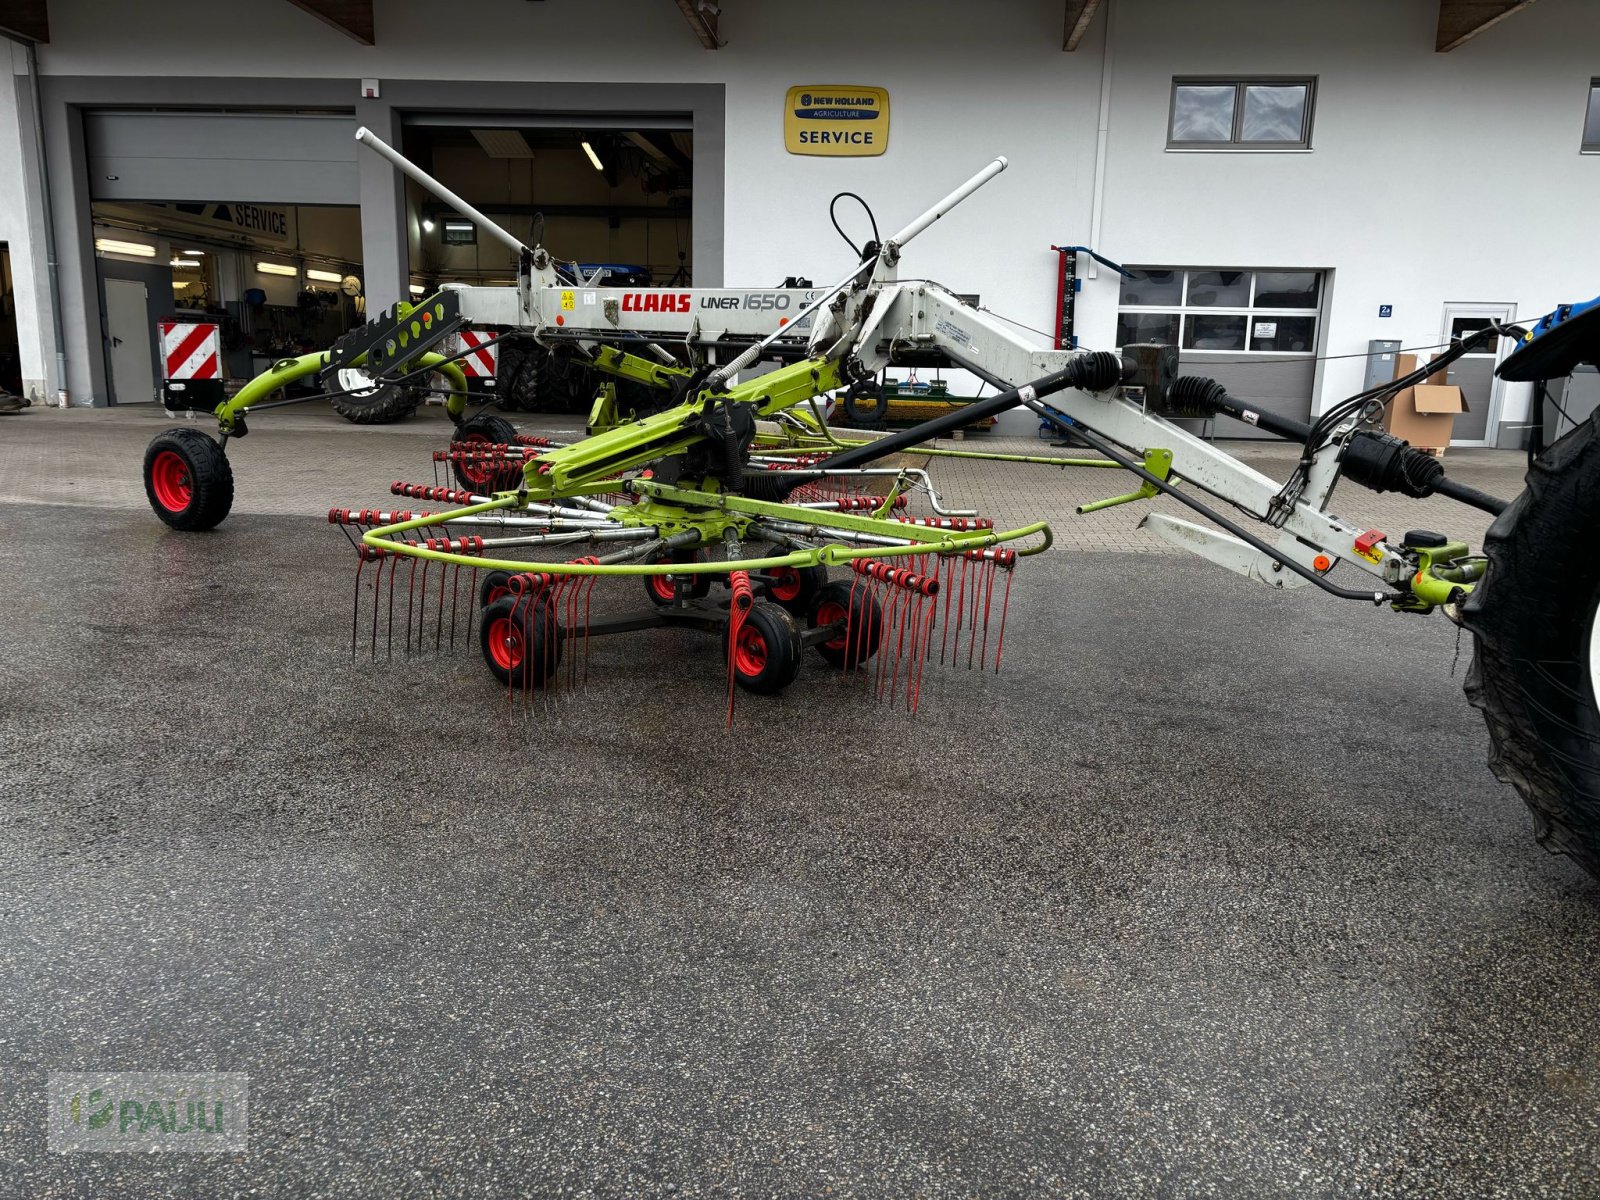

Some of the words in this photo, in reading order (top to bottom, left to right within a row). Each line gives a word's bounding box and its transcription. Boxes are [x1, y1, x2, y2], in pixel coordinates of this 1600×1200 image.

[813, 97, 833, 105] NEW
[834, 97, 874, 106] HOLLAND
[813, 110, 860, 118] AGRICULTURE
[799, 131, 873, 144] SERVICE
[235, 204, 287, 236] SERVICE
[621, 293, 692, 313] CLAAS
[700, 297, 740, 310] LINER
[742, 293, 791, 311] 1650
